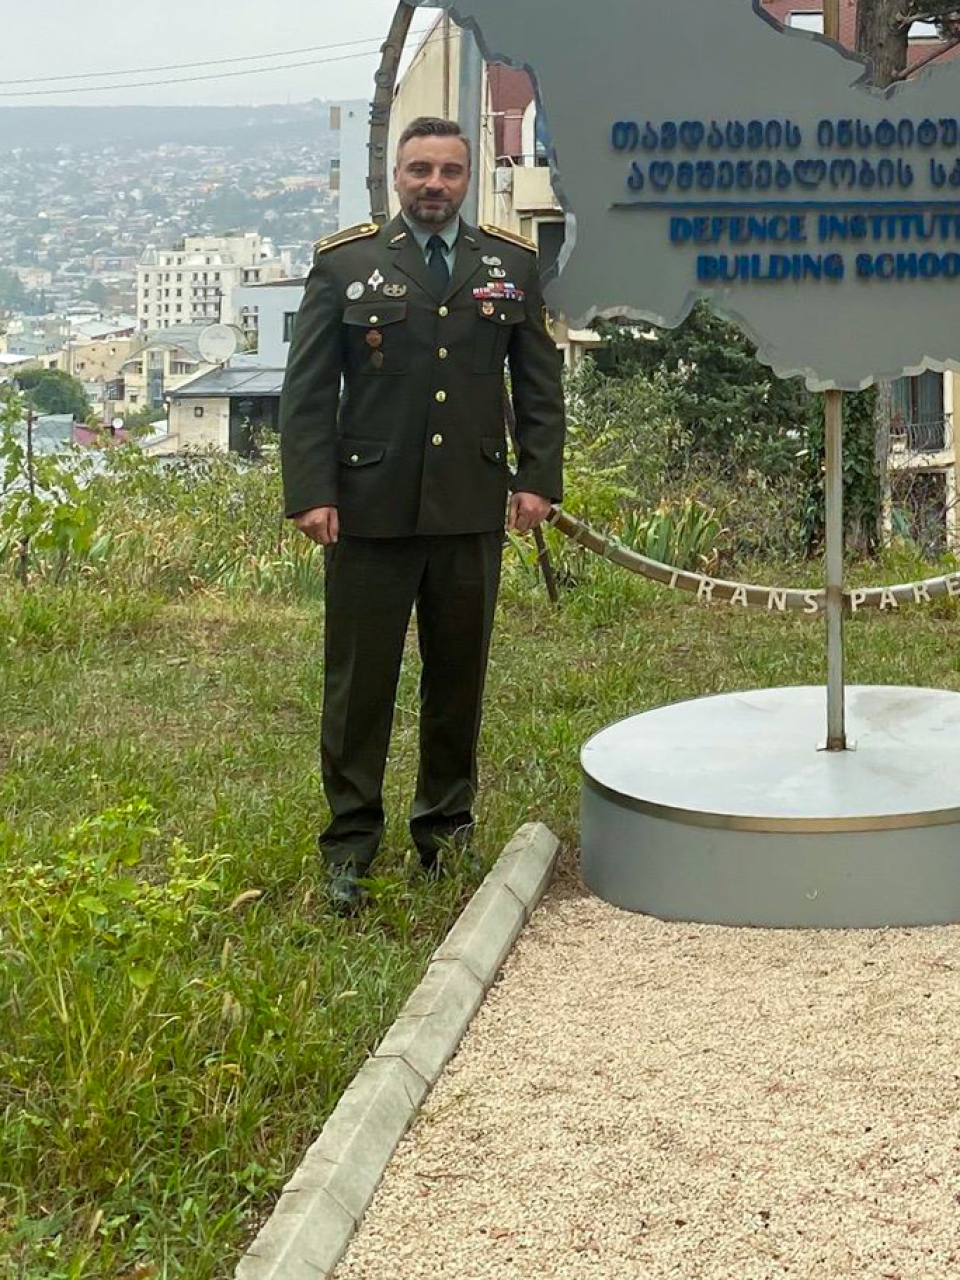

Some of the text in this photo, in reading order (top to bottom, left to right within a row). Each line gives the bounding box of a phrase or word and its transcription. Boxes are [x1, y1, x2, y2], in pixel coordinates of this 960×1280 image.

[611, 119, 801, 150] თავდაცვის
[627, 157, 913, 191] აღმშენებლობის
[669, 213, 807, 245] DEFENCE
[697, 254, 844, 284] BUILDING
